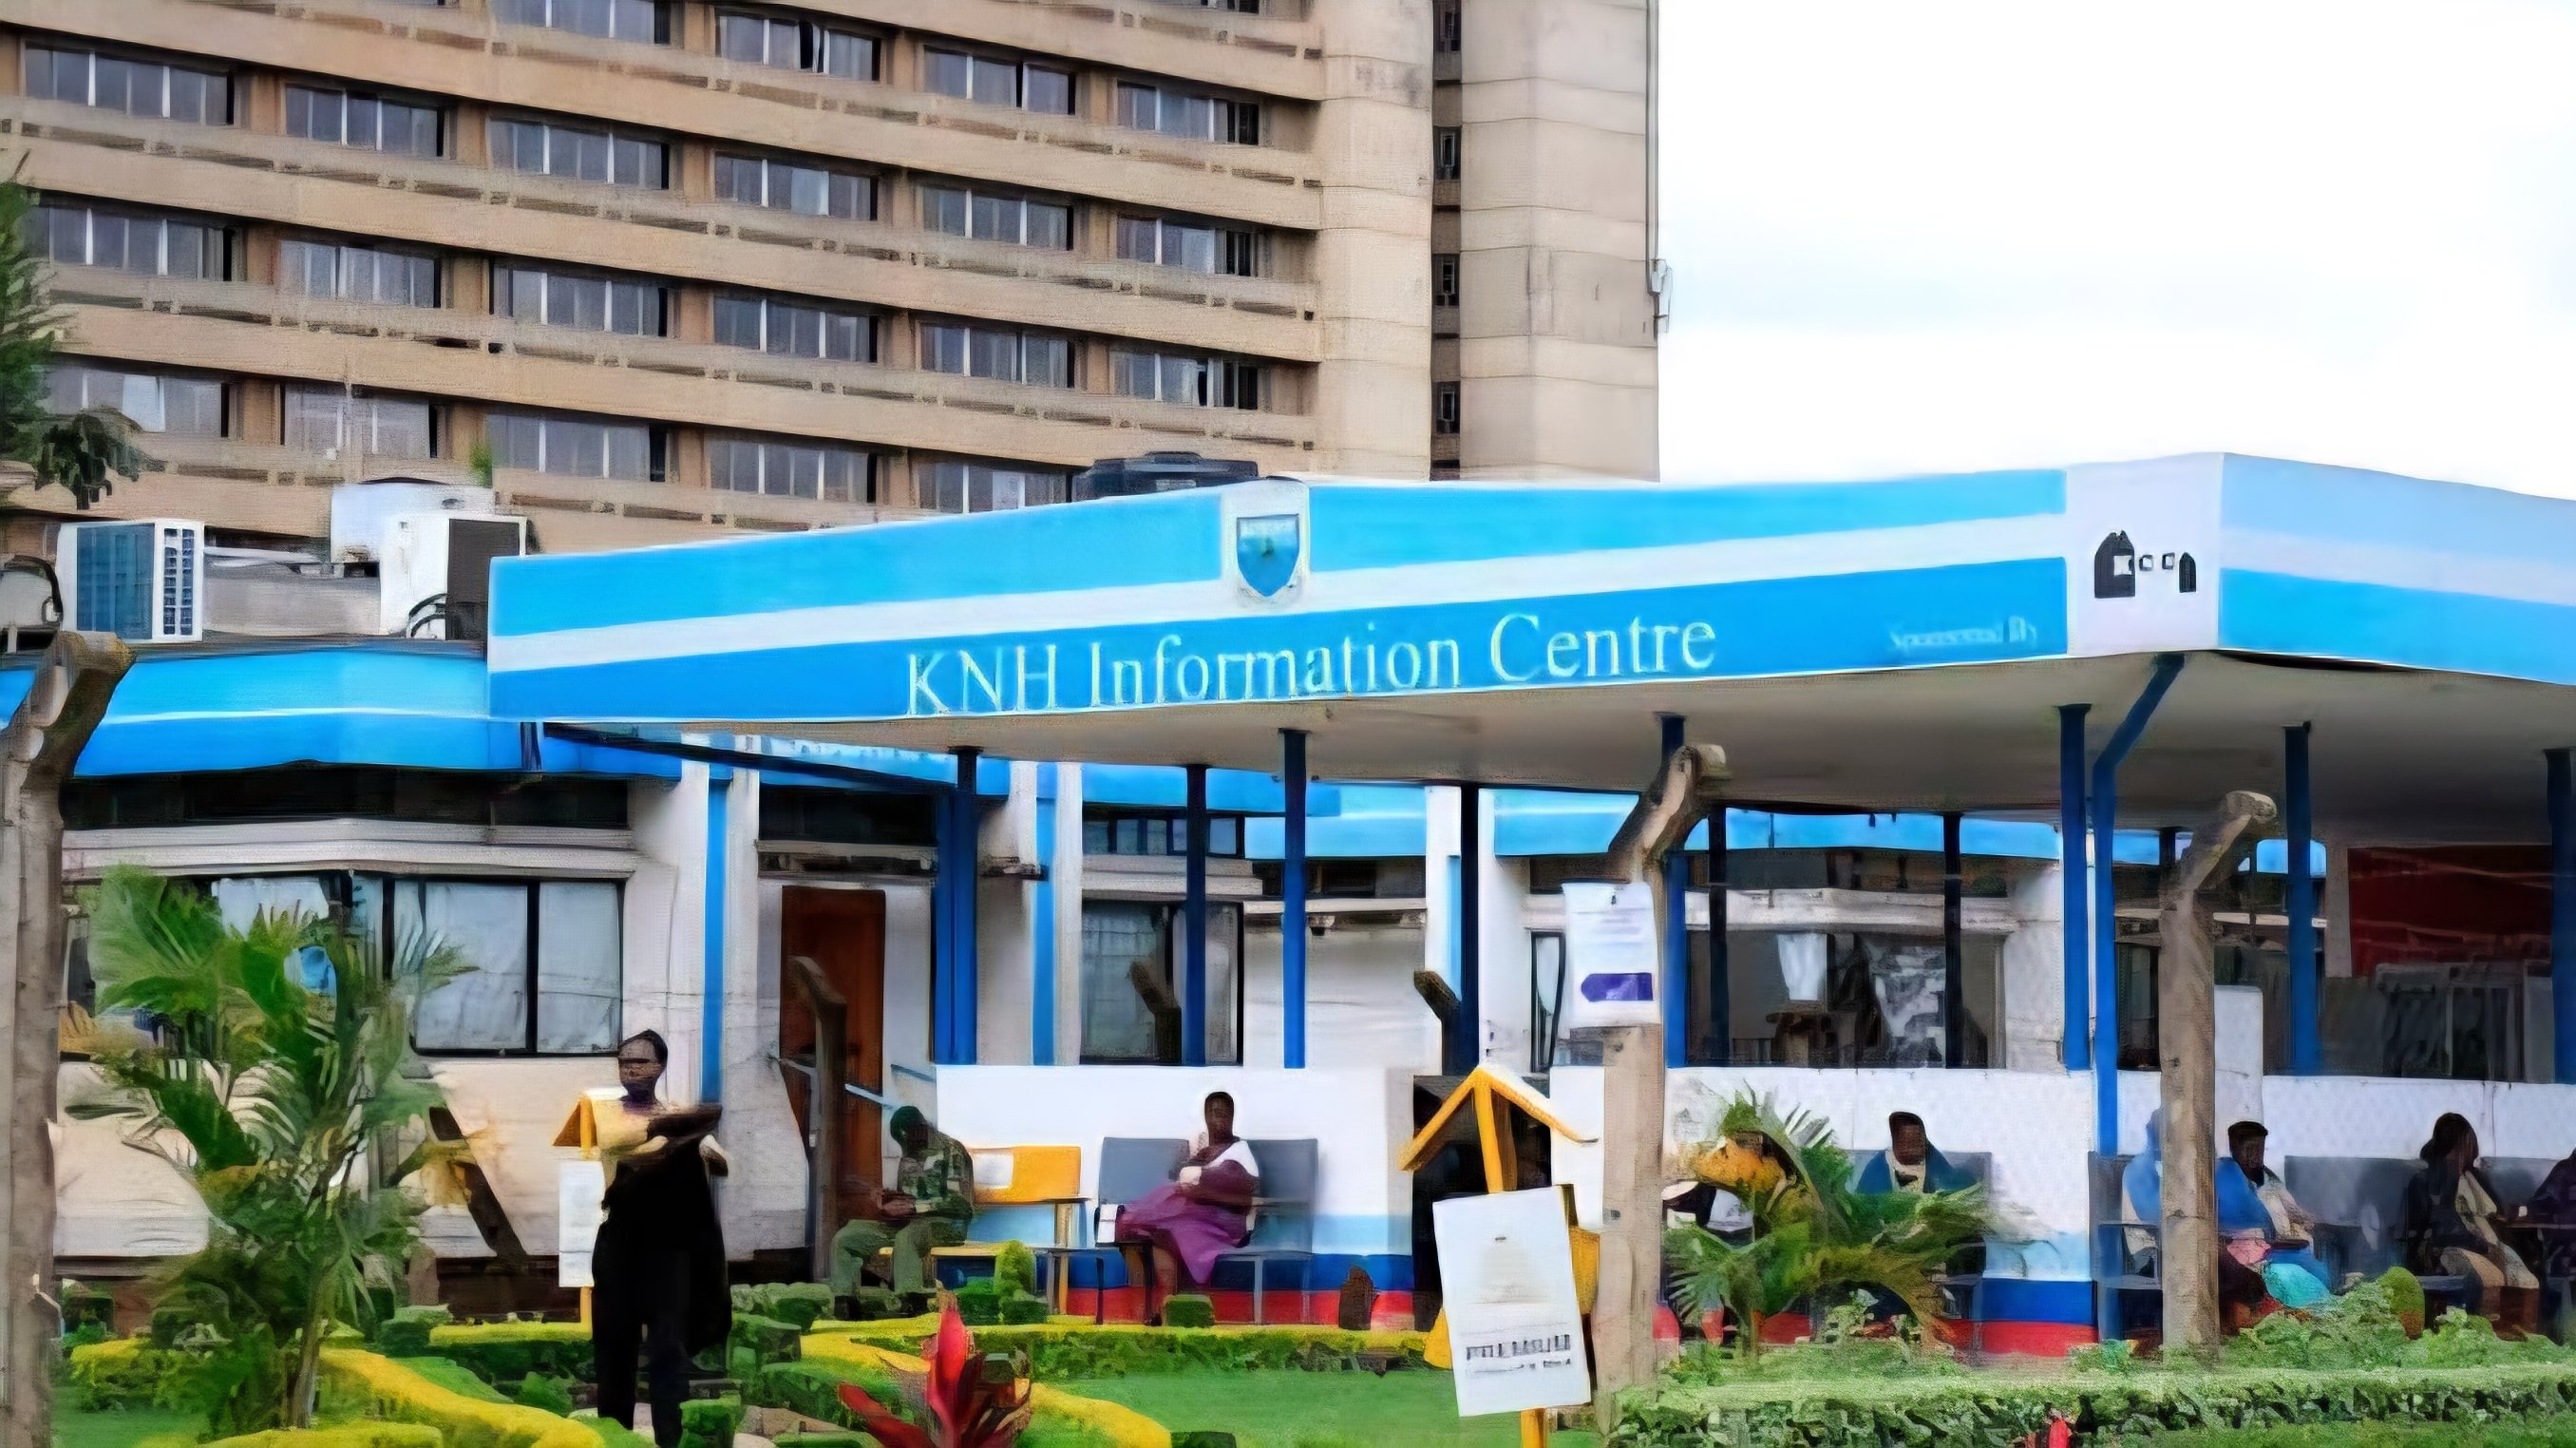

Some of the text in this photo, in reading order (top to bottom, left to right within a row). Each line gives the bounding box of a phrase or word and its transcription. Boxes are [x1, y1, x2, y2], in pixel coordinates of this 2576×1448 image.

[907, 613, 1715, 715] KNH Information Centre
